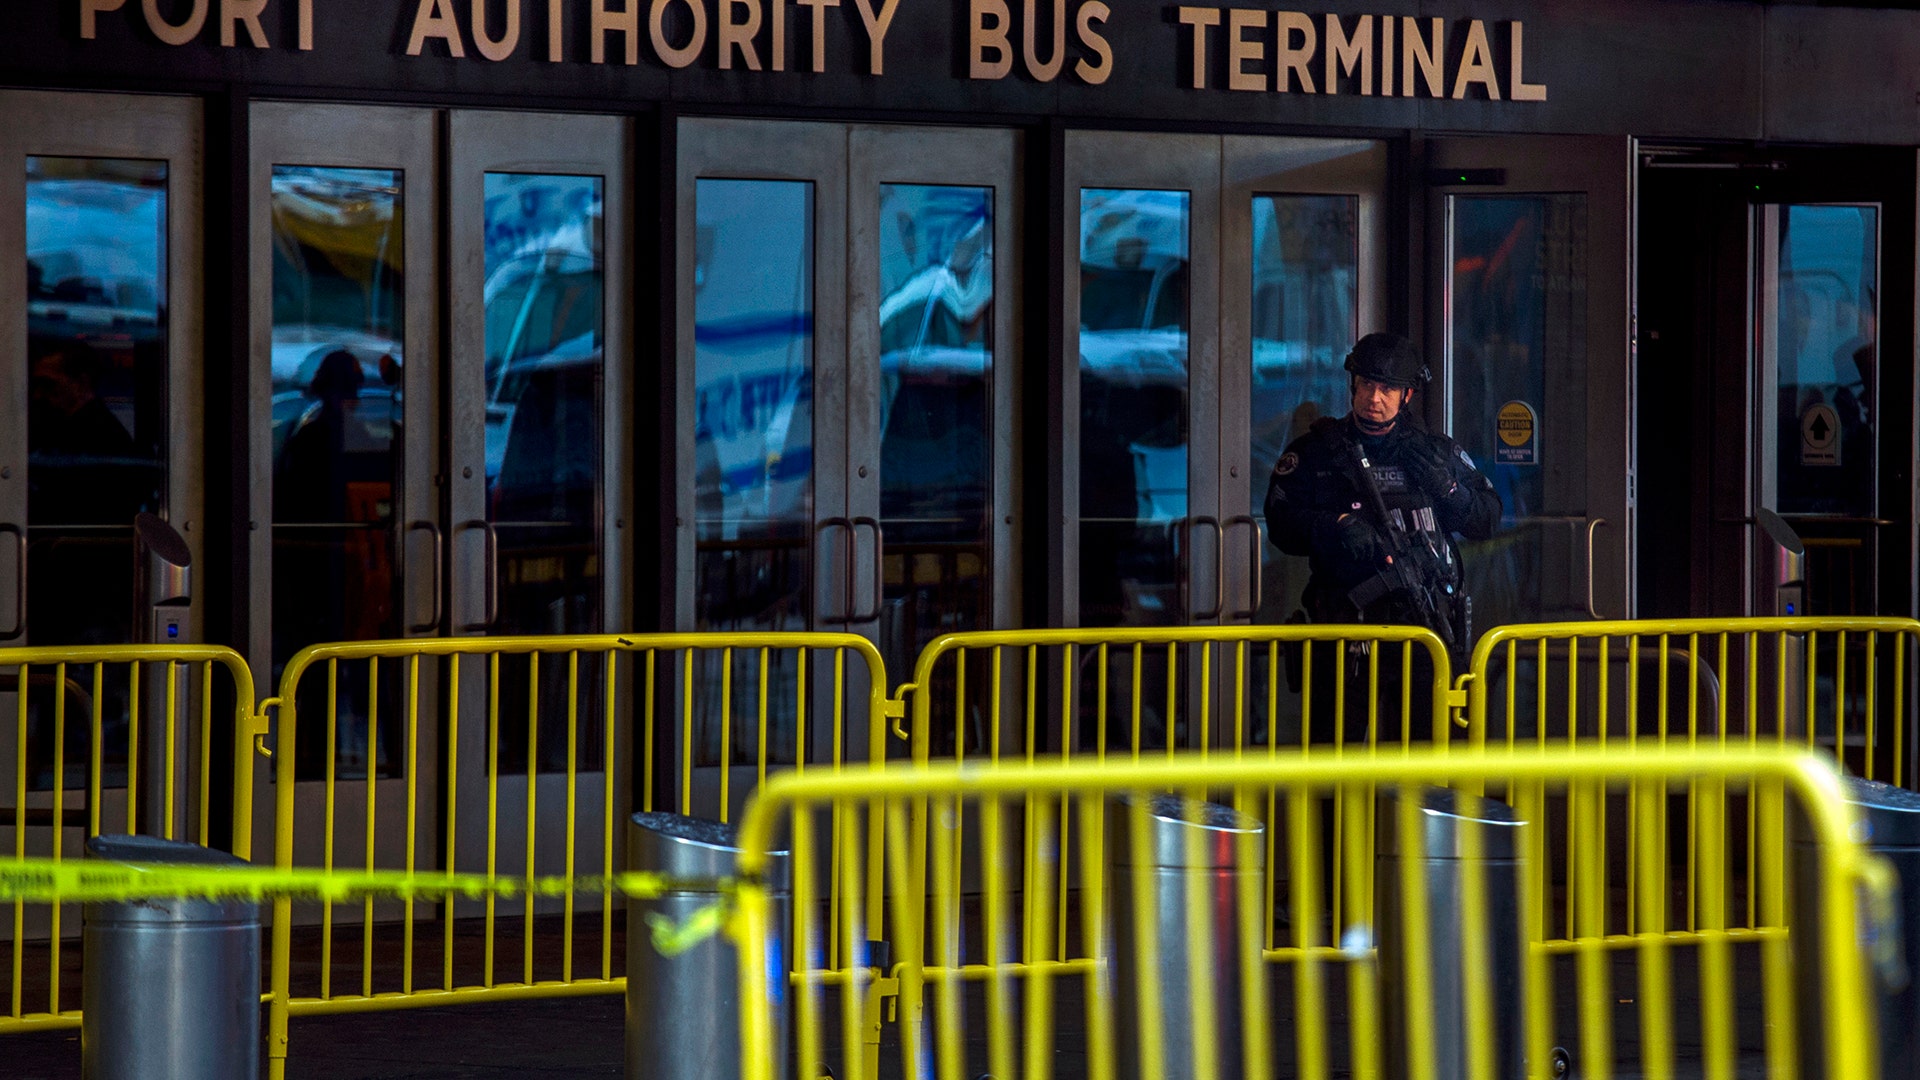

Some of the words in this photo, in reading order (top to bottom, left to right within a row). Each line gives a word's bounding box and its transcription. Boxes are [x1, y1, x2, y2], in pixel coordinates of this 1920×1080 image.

[405, 0, 900, 77] AUTHORITY
[969, 0, 1113, 85] BUS
[1179, 6, 1547, 101] TERMINAL
[1499, 420, 1531, 429] CAUTION
[1373, 471, 1405, 481] OLICE
